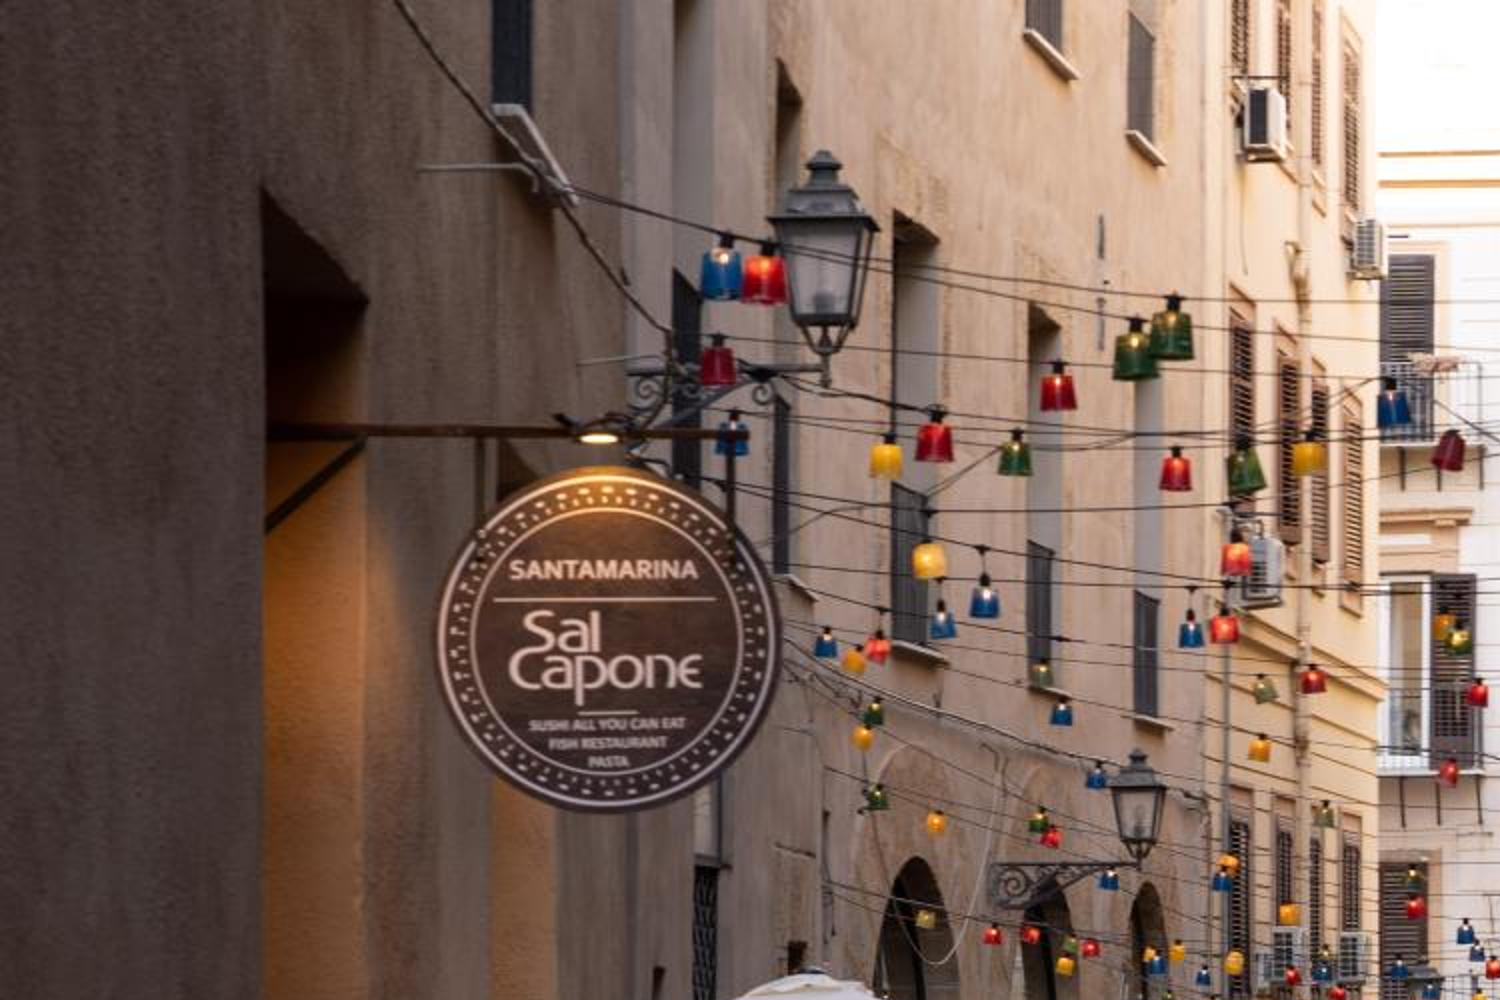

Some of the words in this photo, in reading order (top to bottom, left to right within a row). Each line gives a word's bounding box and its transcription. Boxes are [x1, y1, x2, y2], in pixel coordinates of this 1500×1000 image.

[509, 559, 700, 580] SANTAMARINA
[523, 610, 600, 653] Sal
[508, 648, 703, 706] Capone
[572, 719, 597, 731] ALL
[598, 718, 628, 730] YOU
[630, 717, 659, 730] CAN
[661, 717, 687, 729] EAT
